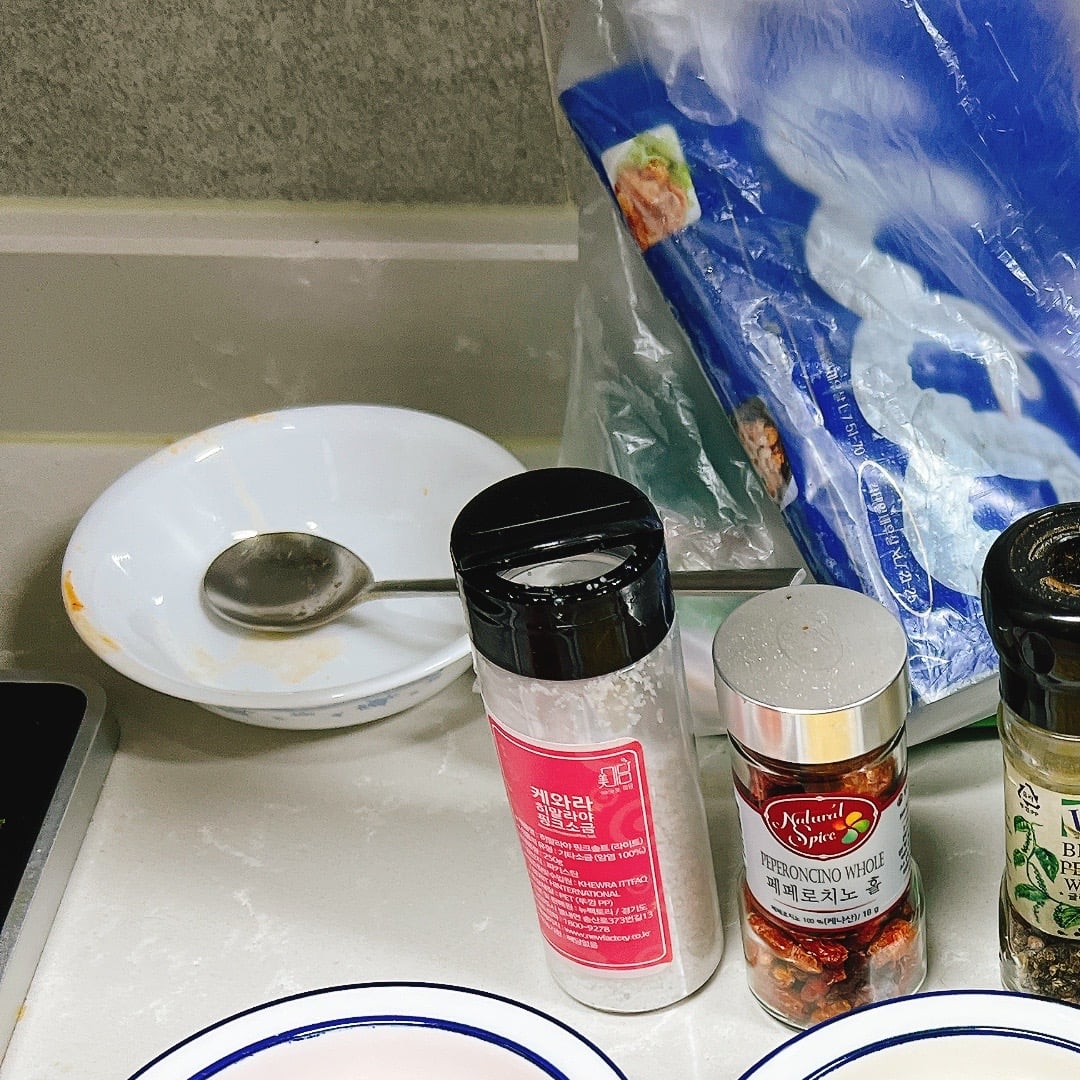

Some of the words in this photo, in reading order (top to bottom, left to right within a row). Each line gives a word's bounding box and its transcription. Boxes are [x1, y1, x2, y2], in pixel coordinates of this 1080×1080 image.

[530, 785, 594, 812] 케와라
[536, 802, 594, 822] 히말라야
[538, 813, 595, 834] 핑크소금
[772, 802, 844, 829] Natural
[788, 826, 836, 849] Spice
[760, 850, 841, 884] PEPERONCINO
[845, 850, 885, 880] WHOLE
[767, 876, 858, 905] 페페로치노
[865, 875, 882, 896] 홀
